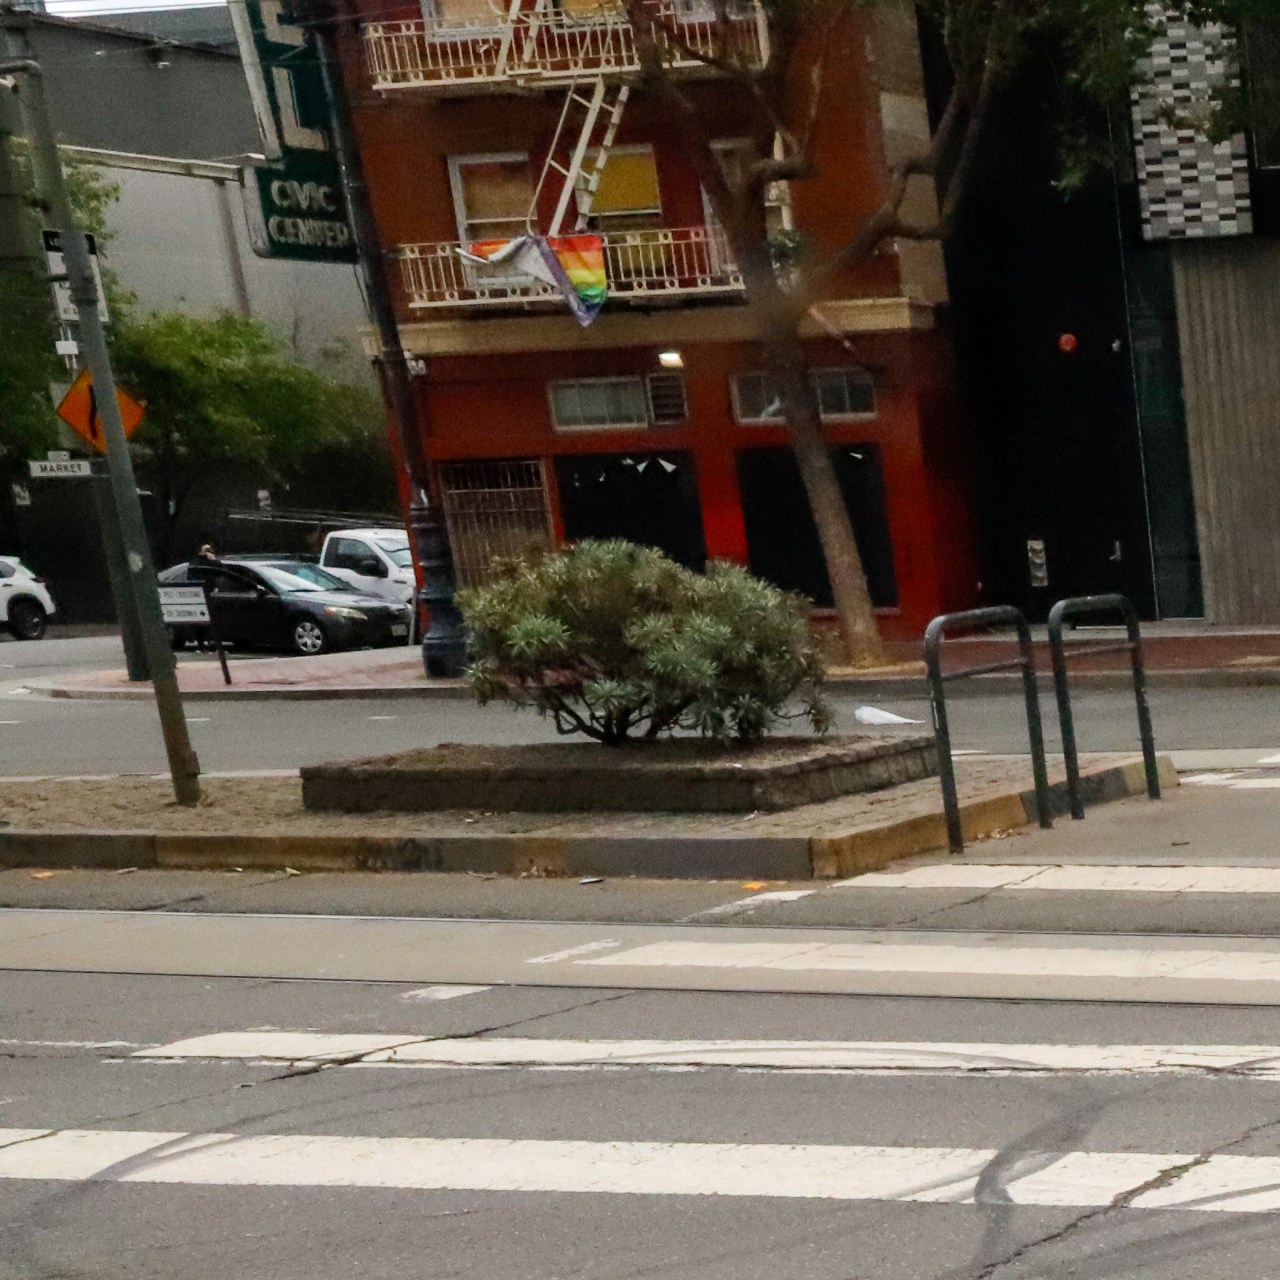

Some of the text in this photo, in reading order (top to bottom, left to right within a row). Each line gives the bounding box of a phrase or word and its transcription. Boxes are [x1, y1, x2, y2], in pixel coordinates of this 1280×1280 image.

[270, 180, 337, 212] CIVIC
[267, 215, 350, 247] CENTER
[39, 463, 82, 473] MARKET
